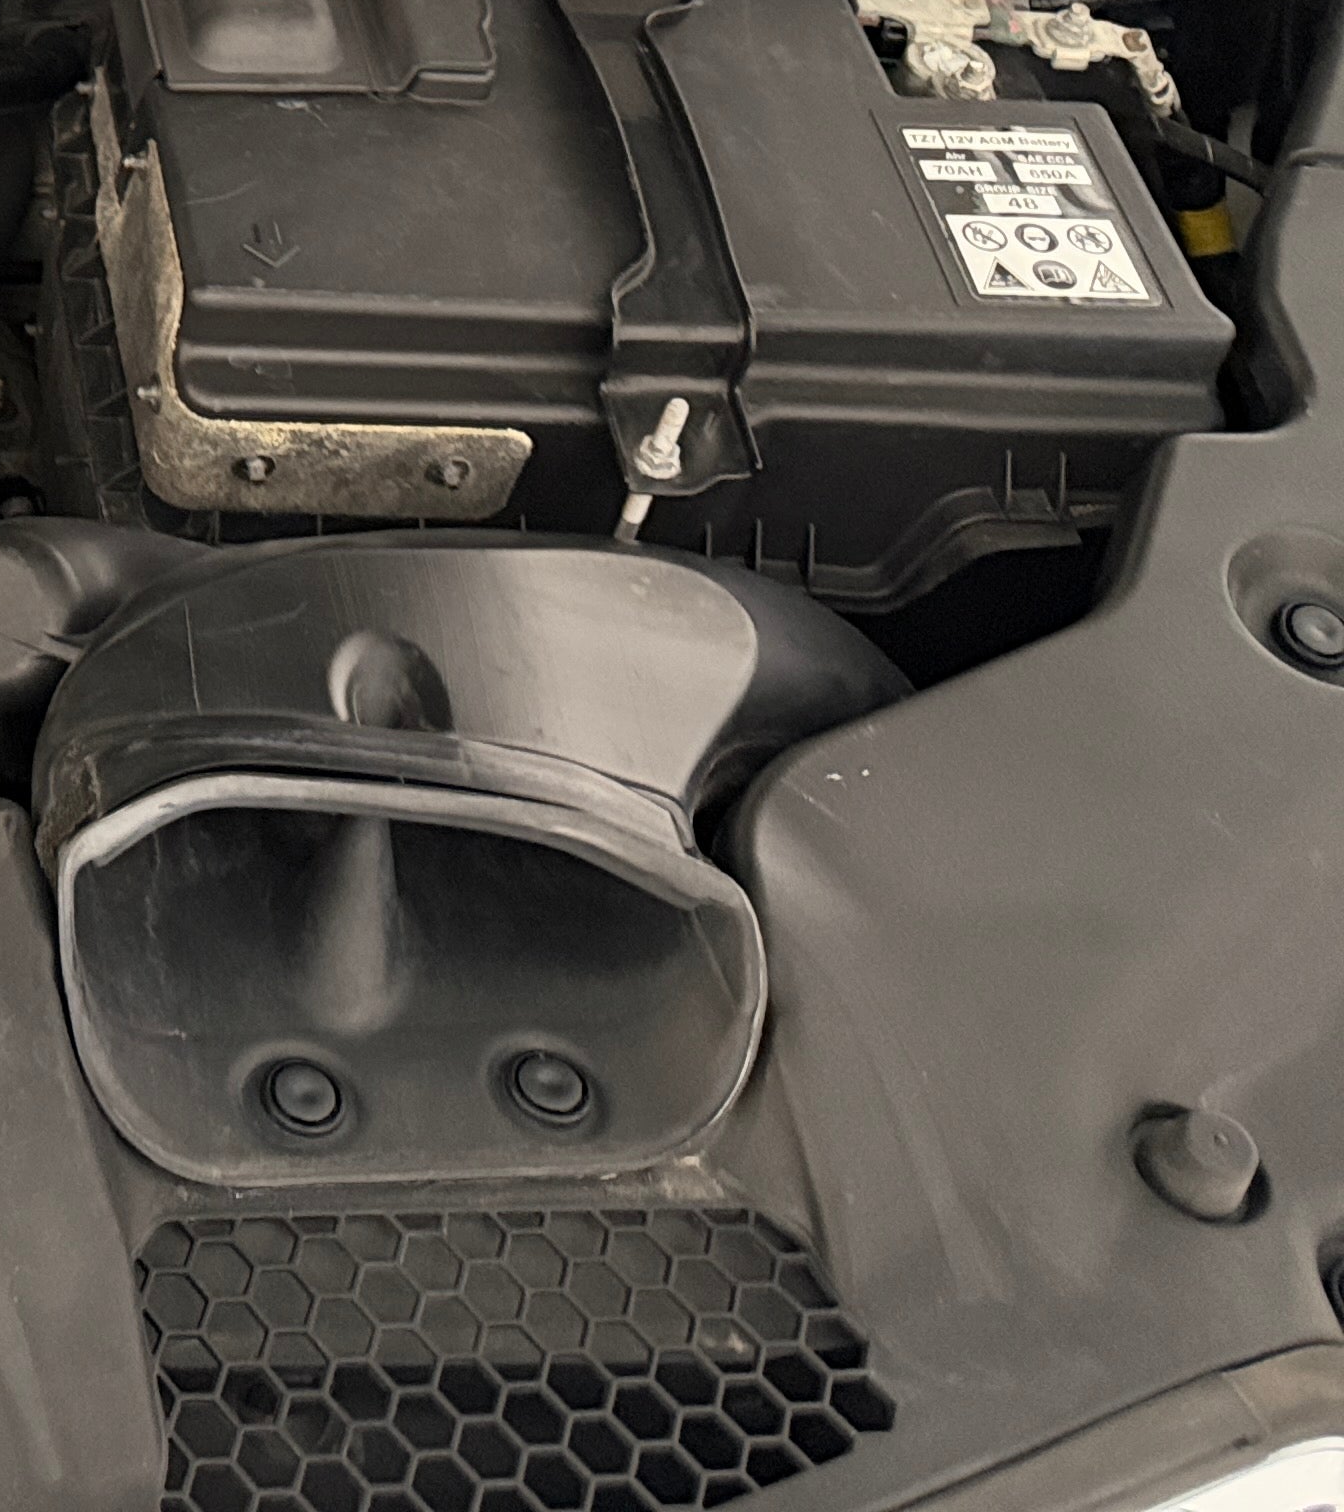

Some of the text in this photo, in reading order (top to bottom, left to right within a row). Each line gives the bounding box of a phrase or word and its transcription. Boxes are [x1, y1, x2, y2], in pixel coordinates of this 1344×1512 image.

[948, 134, 974, 144] 12V
[979, 136, 1015, 146] AGM
[1018, 137, 1070, 149] Battery
[933, 164, 984, 176] 70AH
[1029, 169, 1078, 180] 650A
[974, 183, 1058, 196] GROUP SIZE
[1008, 197, 1039, 210] 48
